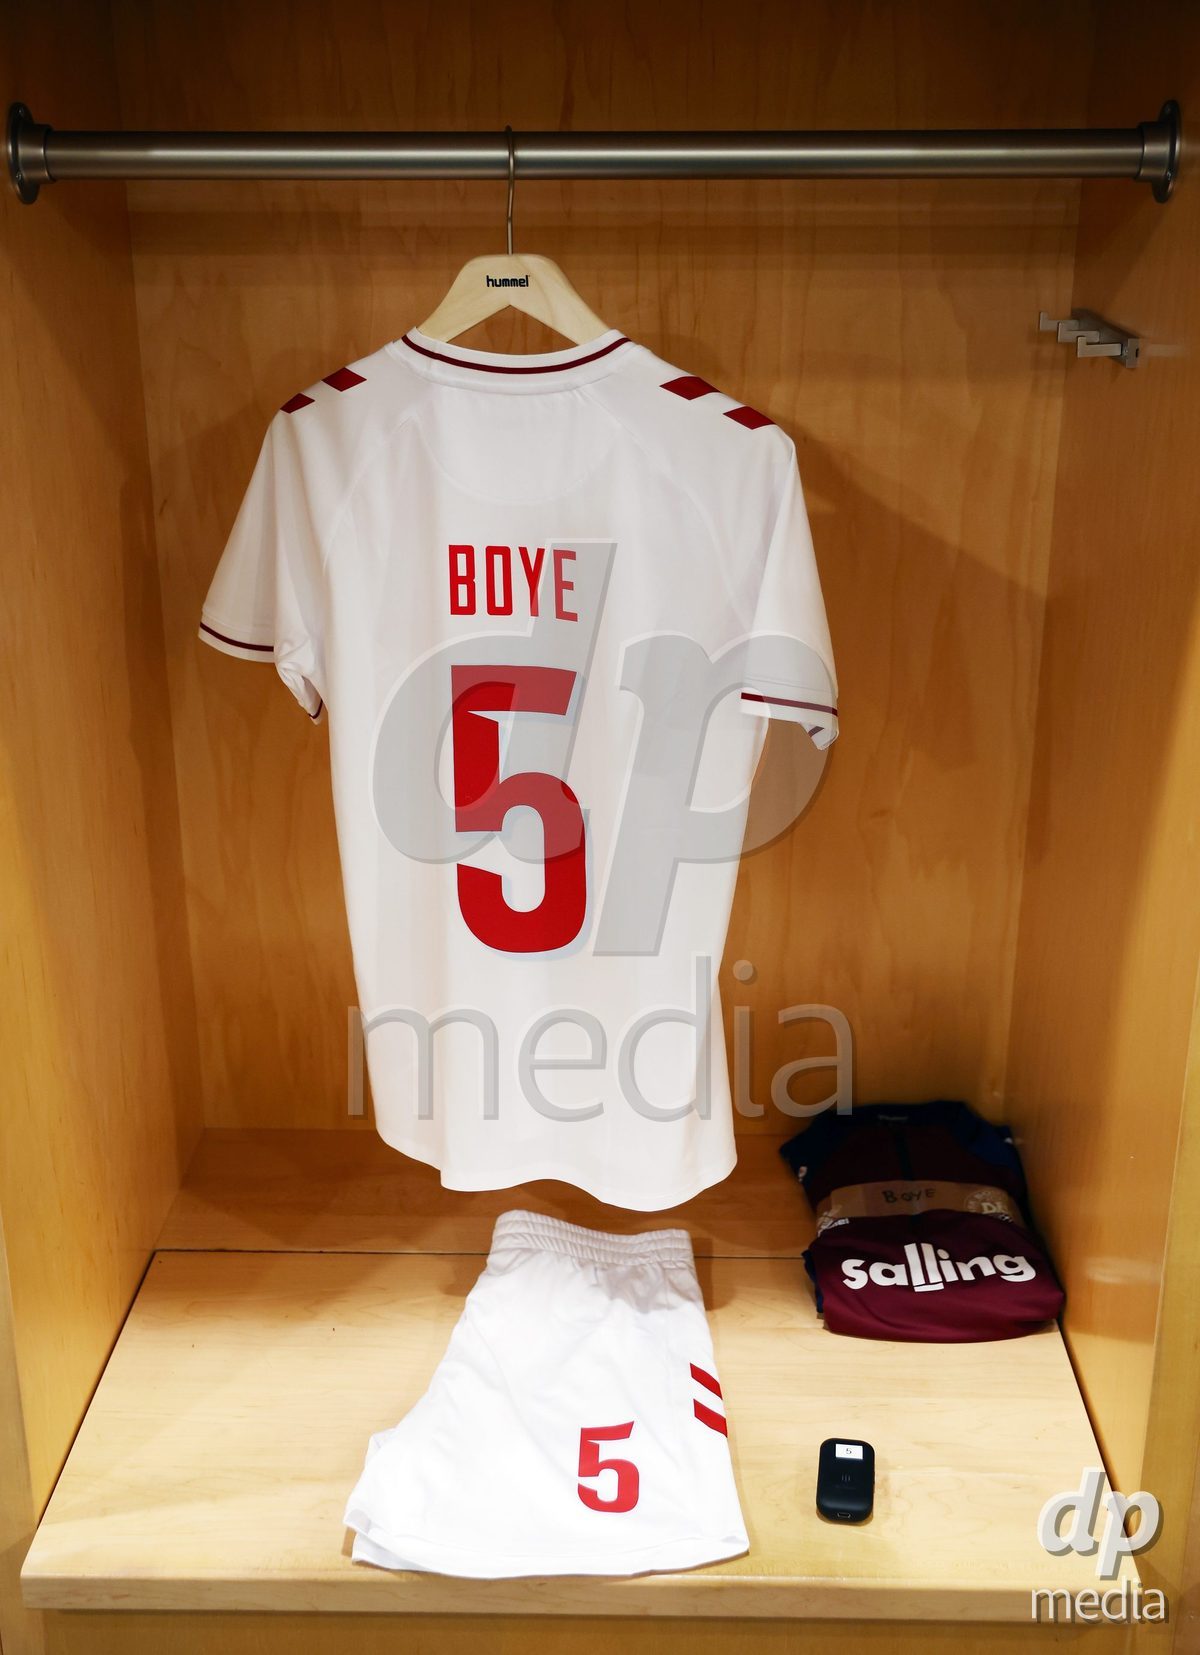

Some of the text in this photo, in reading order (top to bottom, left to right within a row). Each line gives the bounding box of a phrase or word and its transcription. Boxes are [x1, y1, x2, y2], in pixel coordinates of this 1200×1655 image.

[486, 275, 529, 288] hummel
[449, 545, 578, 622] BOYE
[451, 665, 587, 953] 5
[841, 1243, 1036, 1293] salling
[577, 1421, 640, 1513] 5
[845, 1447, 853, 1455] 5
